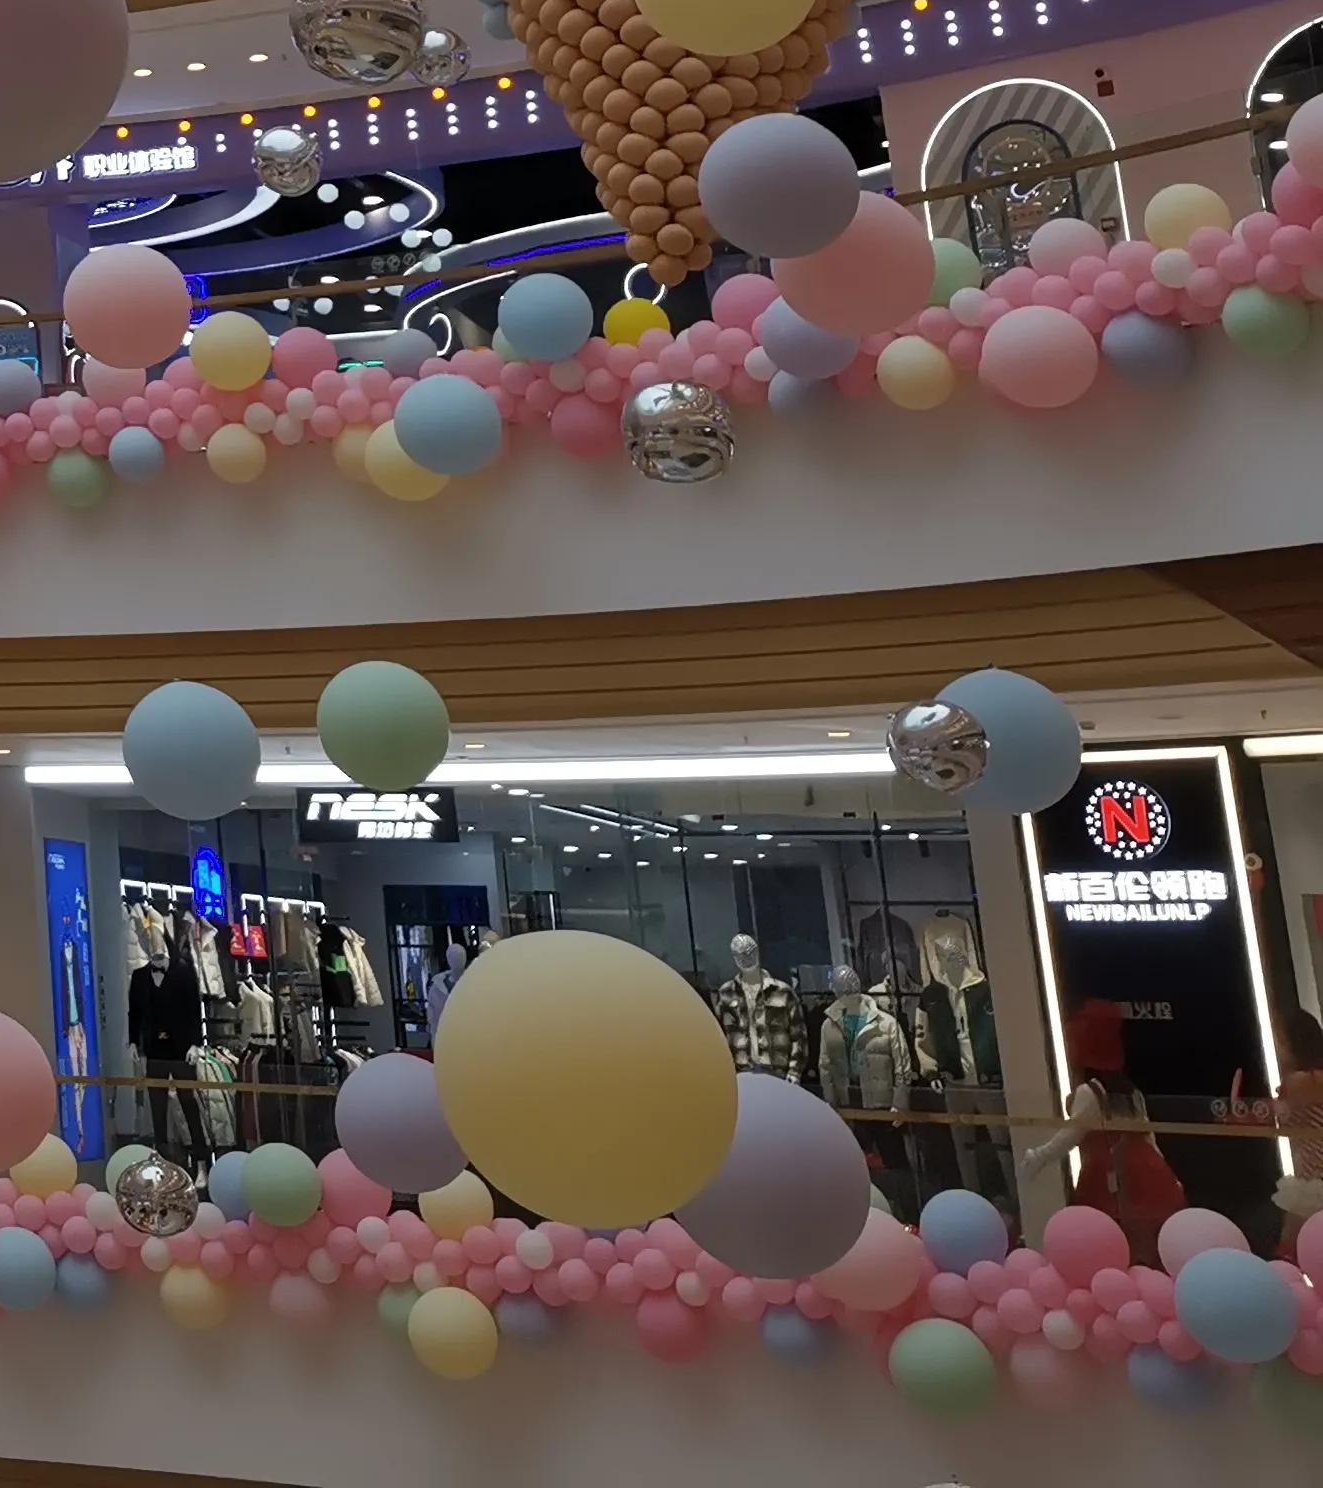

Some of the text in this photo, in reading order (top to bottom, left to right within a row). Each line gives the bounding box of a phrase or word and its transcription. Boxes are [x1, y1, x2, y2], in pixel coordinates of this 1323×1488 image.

[83, 145, 196, 178] 职业体验馆
